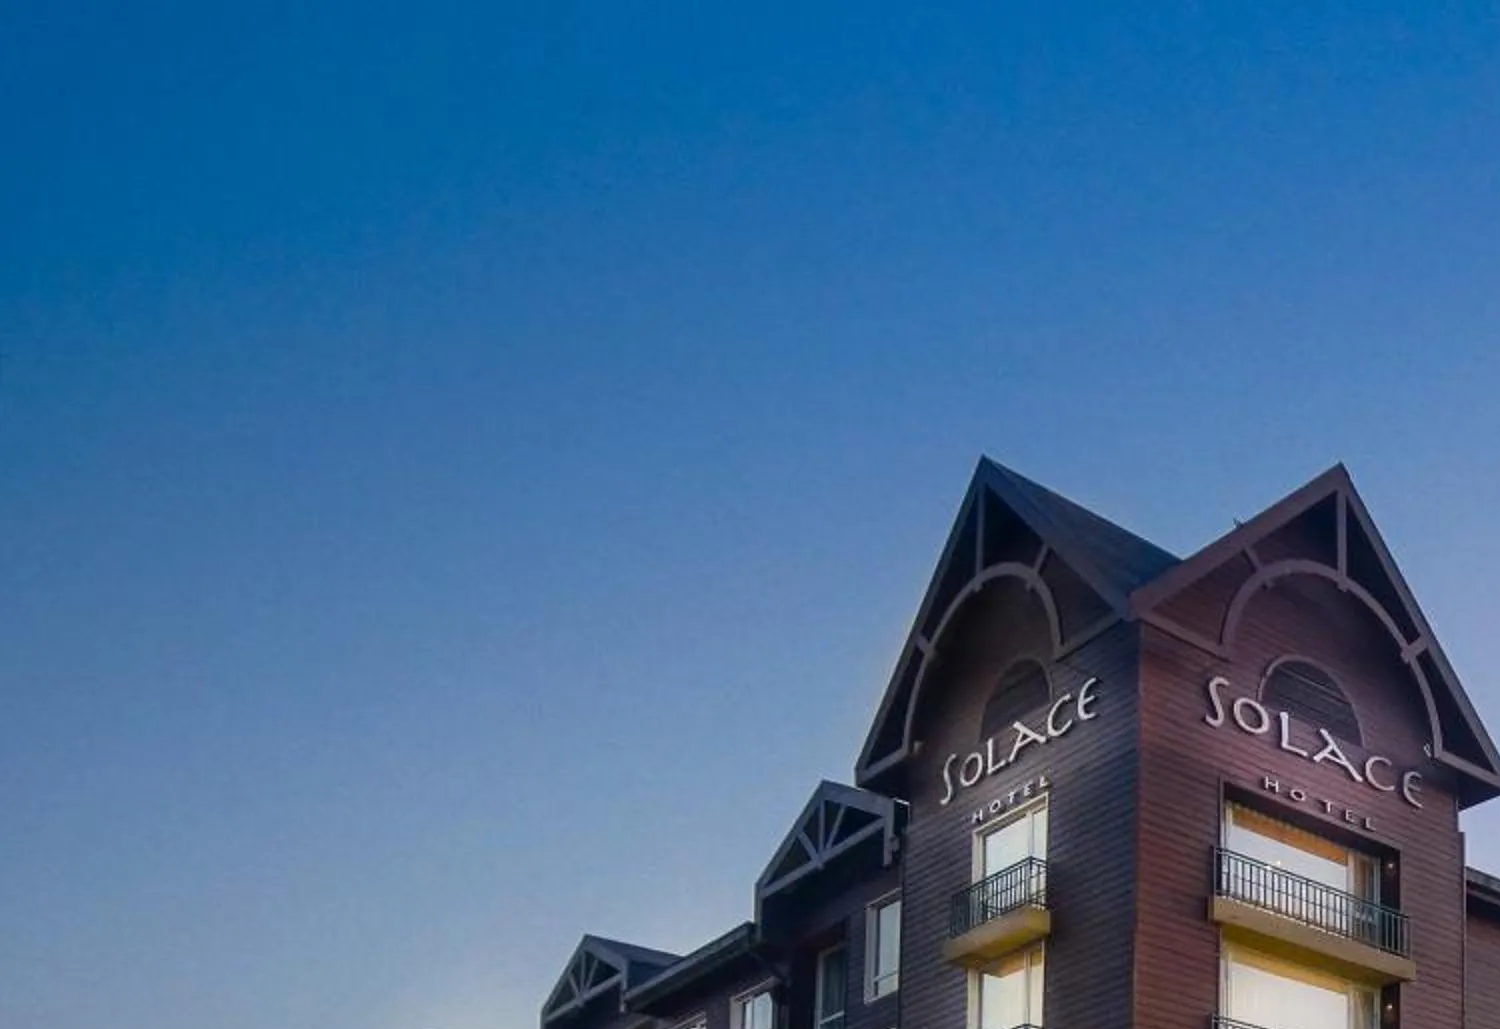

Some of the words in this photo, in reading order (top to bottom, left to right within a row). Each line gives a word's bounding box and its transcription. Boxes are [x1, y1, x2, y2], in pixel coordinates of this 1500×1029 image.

[940, 677, 1101, 805] SOLACE
[1205, 676, 1424, 809] SOLACE
[972, 776, 1050, 823] HOTEL
[1264, 775, 1377, 832] HOTEL
